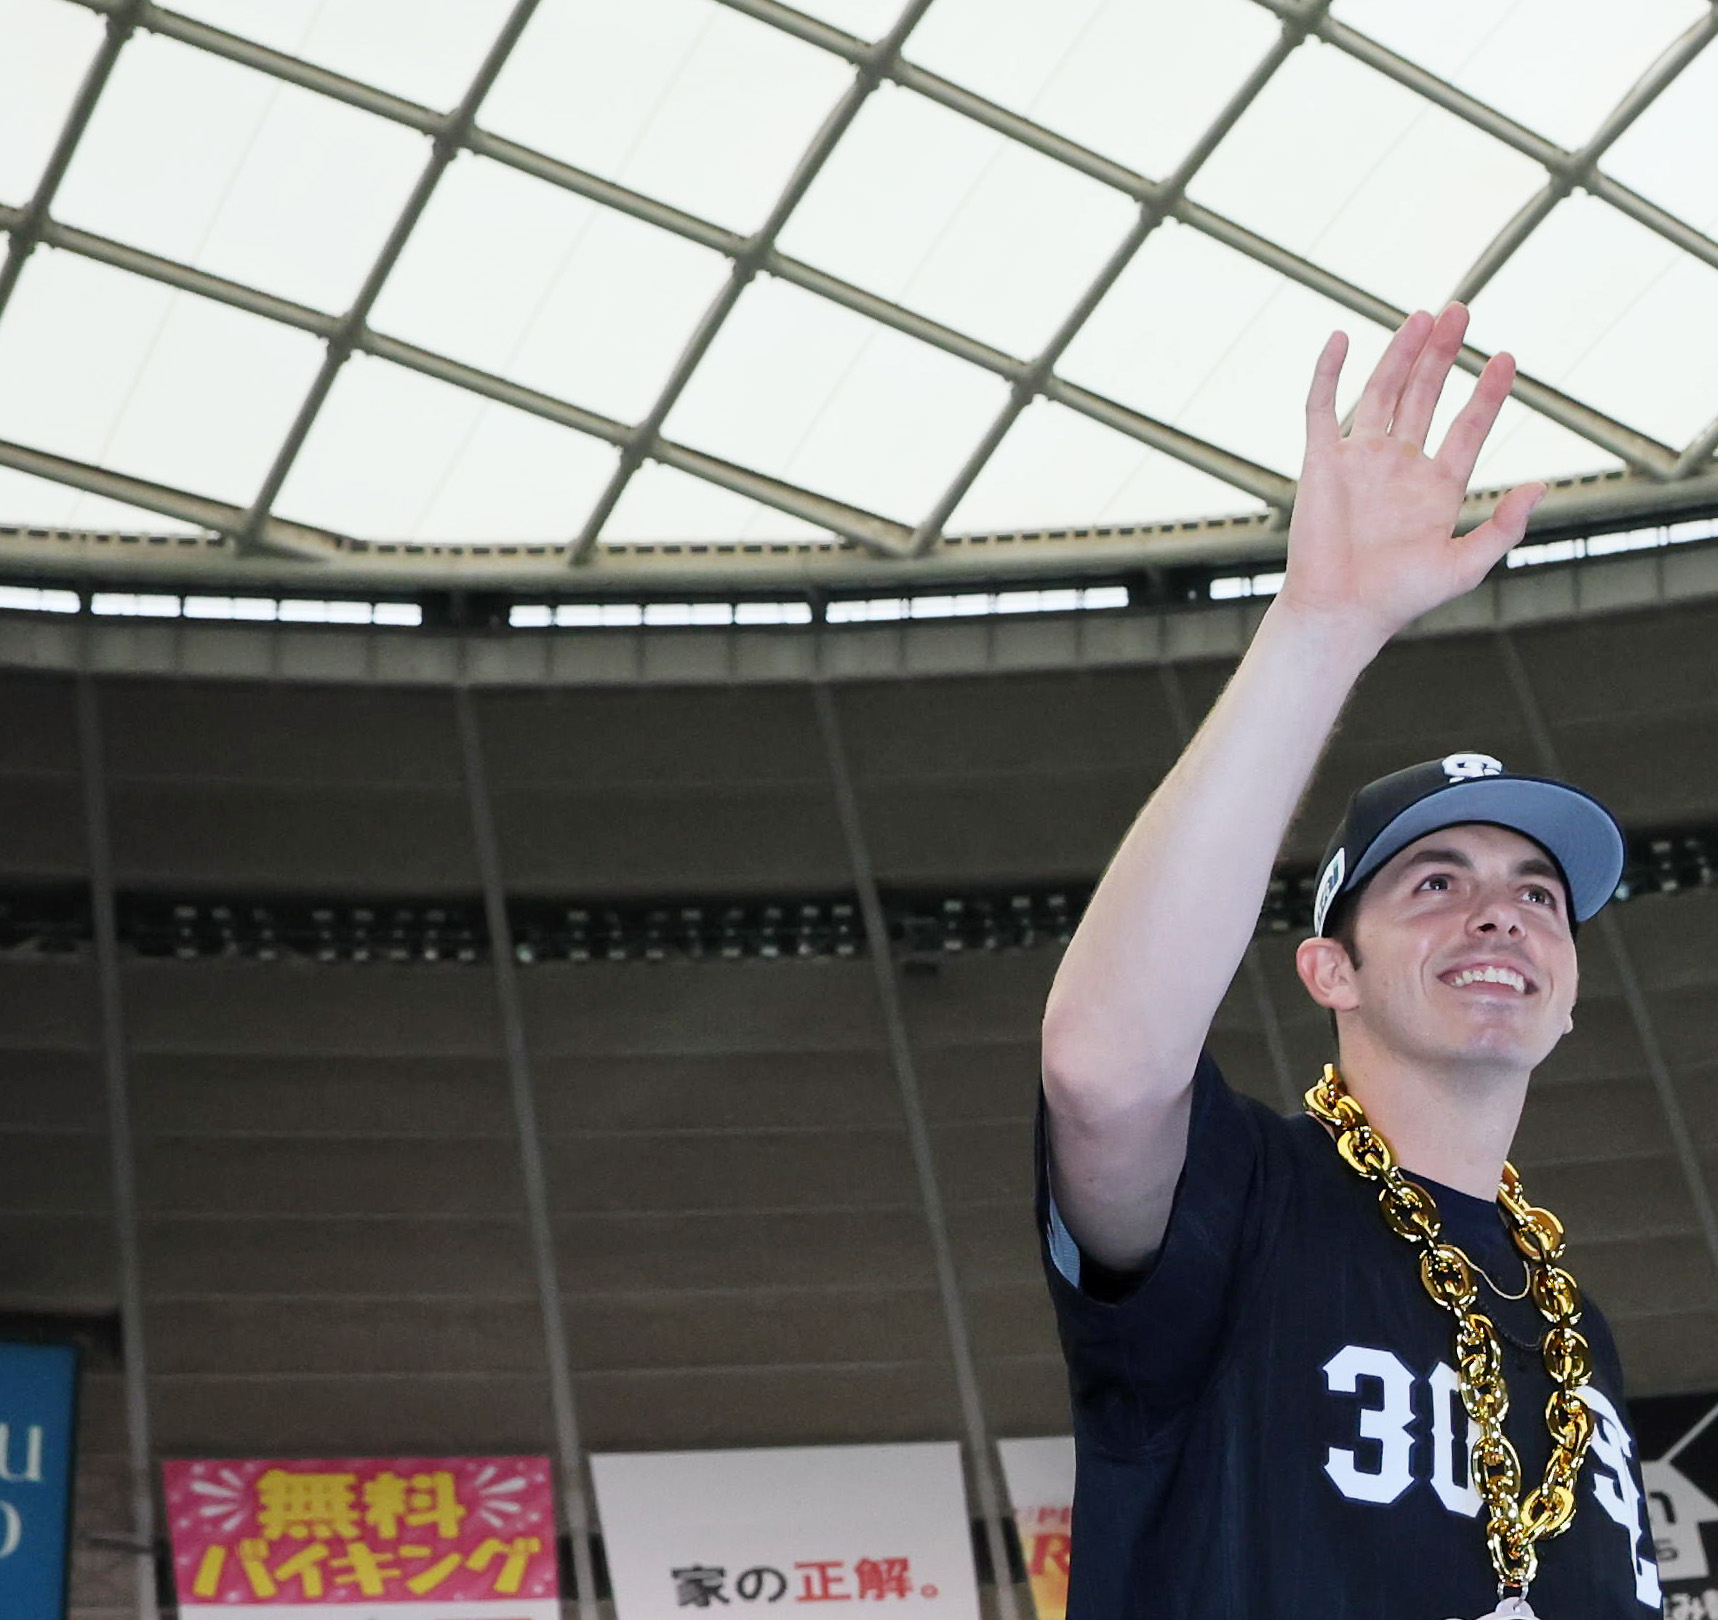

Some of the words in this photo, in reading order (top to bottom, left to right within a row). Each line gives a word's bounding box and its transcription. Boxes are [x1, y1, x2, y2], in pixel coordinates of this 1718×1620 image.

[256, 1469, 467, 1540] 無料
[193, 1537, 542, 1598] バイキング
[669, 1556, 939, 1608] 家の正解。
